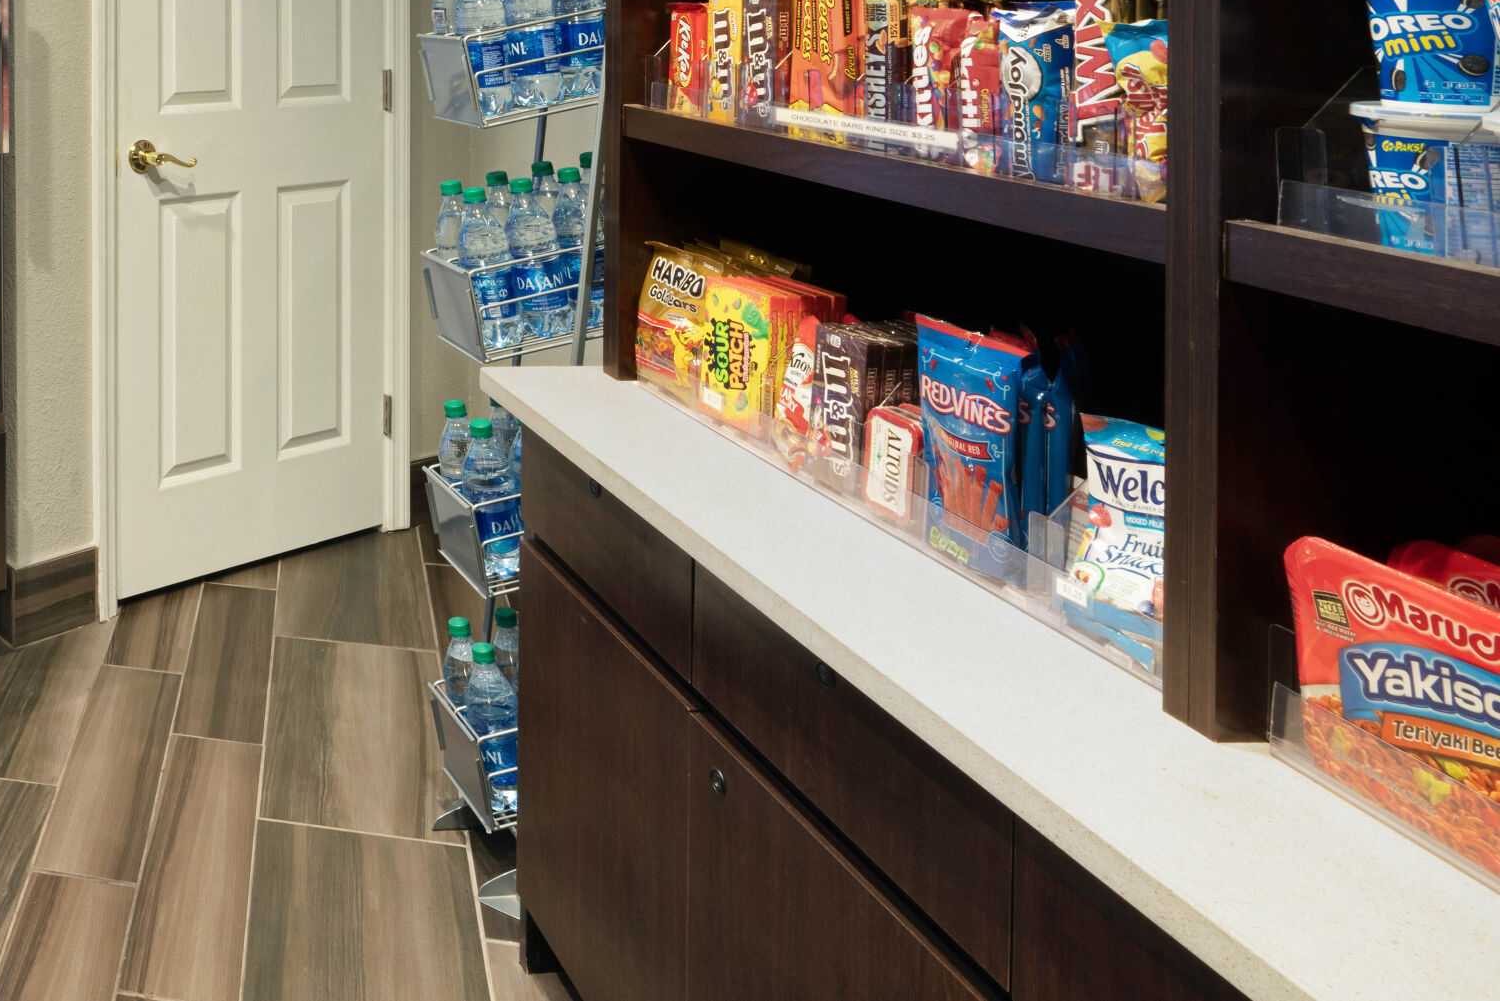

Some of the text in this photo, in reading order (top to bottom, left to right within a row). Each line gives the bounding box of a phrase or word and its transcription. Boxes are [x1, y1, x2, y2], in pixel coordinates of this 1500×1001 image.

[876, 3, 887, 22] SIZE
[1370, 14, 1472, 41] OREO
[1384, 31, 1456, 56] mini
[791, 114, 936, 142] CHOCOLATE BARS KING SIZE $3.25
[652, 257, 705, 297] HARIBO
[715, 321, 730, 384] SOUR
[728, 320, 745, 390] PATCH
[920, 373, 1013, 434] RED VINES
[883, 427, 902, 505] ALTOIDS
[1125, 516, 1148, 526] MIXED
[1392, 719, 1469, 752] Teriyaki
